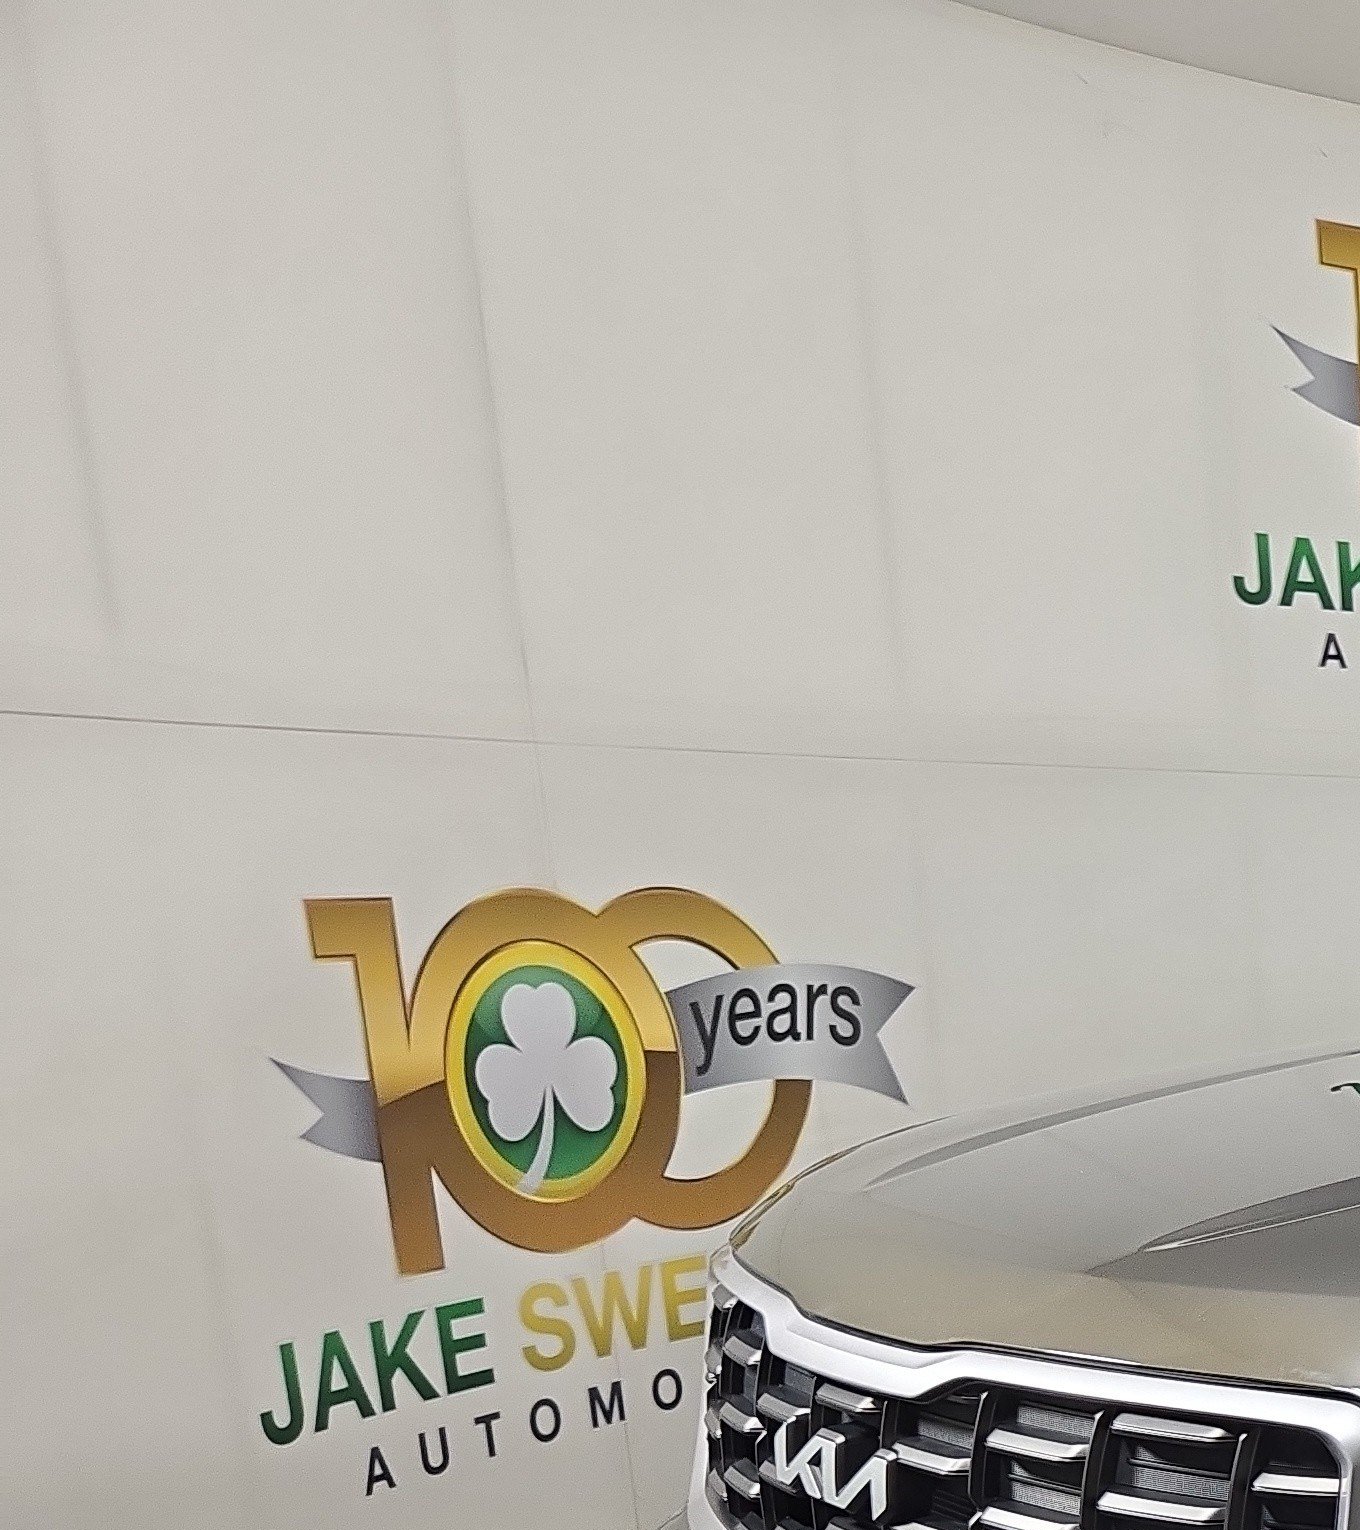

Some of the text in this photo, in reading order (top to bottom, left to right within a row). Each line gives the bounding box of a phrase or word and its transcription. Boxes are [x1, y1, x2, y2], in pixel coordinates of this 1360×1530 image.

[303, 886, 812, 1277] 100
[689, 981, 861, 1074] years
[260, 1297, 495, 1446] JAKE
[364, 1368, 683, 1497] AUTOMO
